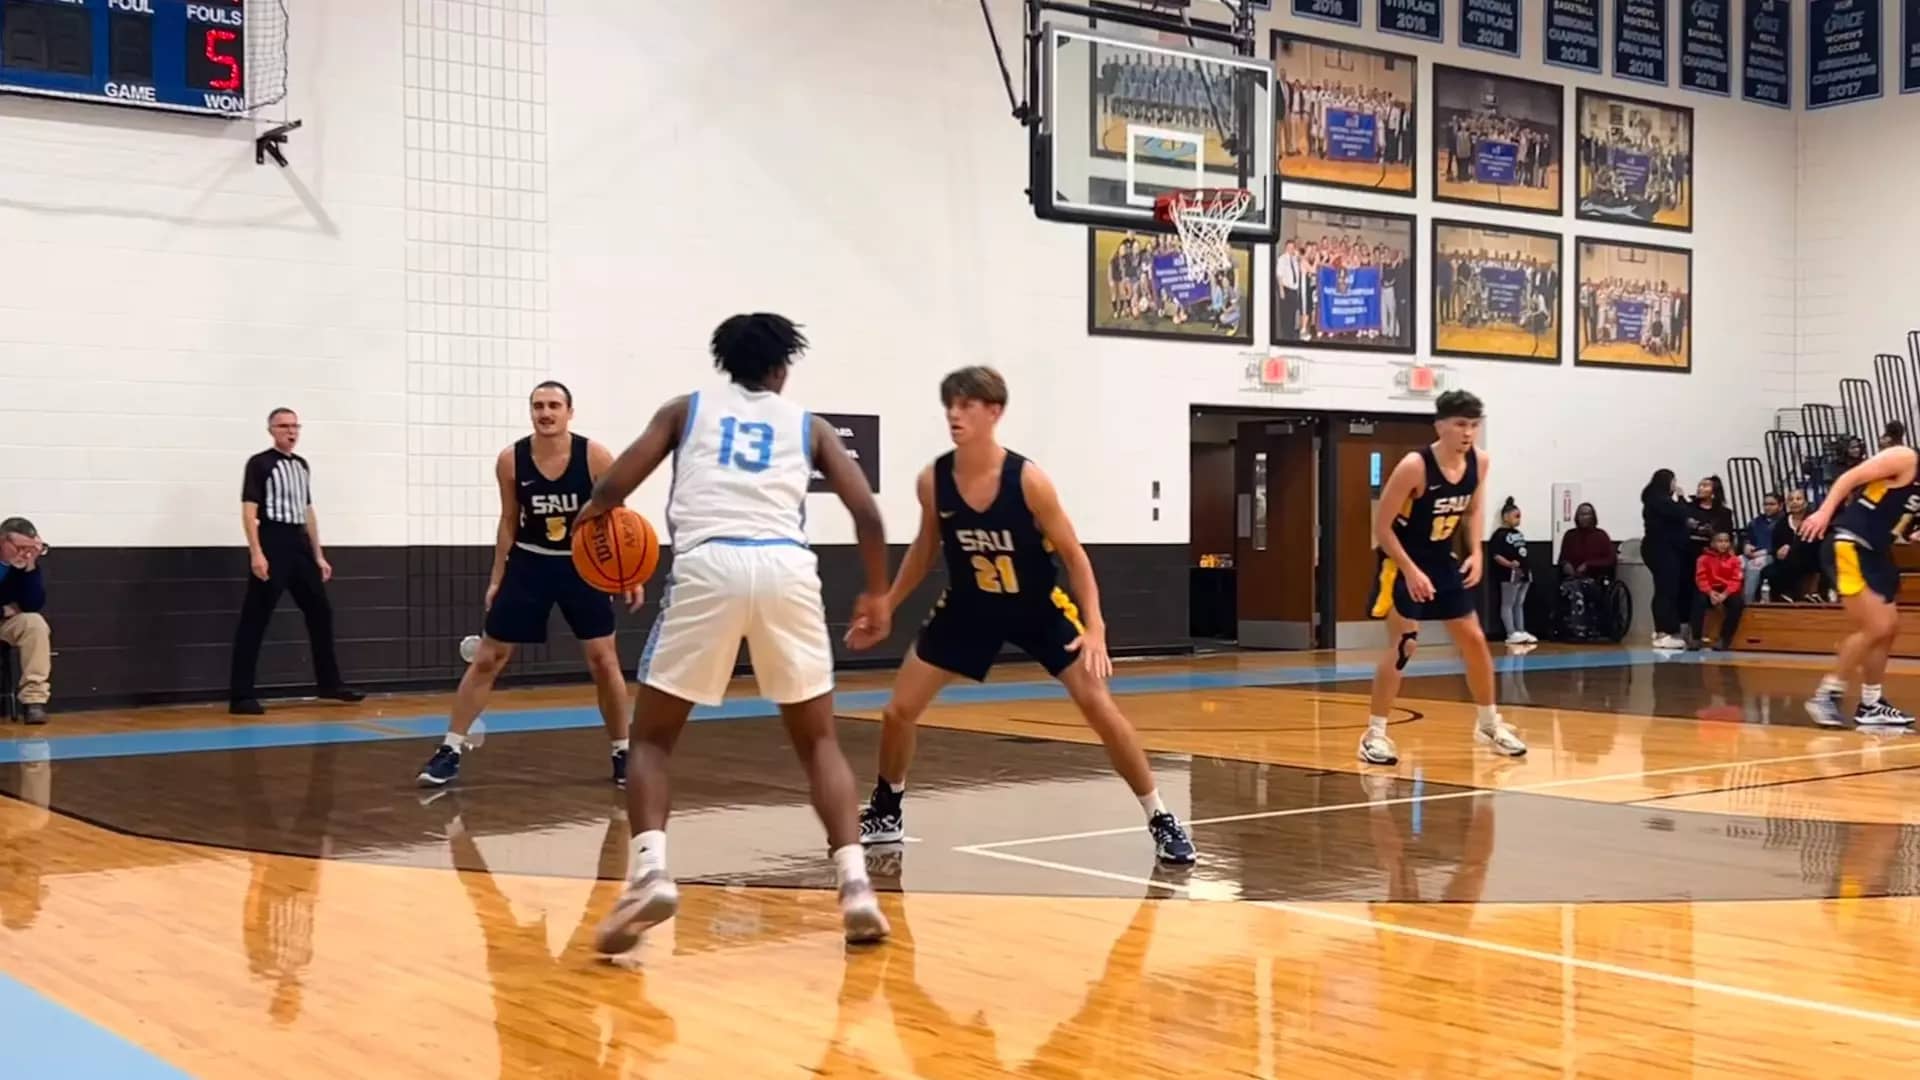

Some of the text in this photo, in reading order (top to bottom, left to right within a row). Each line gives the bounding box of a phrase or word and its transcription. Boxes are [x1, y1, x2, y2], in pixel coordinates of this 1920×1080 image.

[107, 0, 155, 14] FOUL
[187, 4, 242, 26] FOULS
[1827, 40, 1861, 55] SOCCER
[205, 29, 240, 91] 5
[104, 82, 156, 101] GAME
[1826, 80, 1862, 100] 2017
[204, 94, 245, 112] WON
[717, 415, 775, 474] 13
[531, 492, 579, 515] SAU
[1432, 493, 1473, 515] SAU
[545, 515, 567, 542] 5
[955, 528, 1015, 552] SAU
[970, 554, 1020, 594] 21
